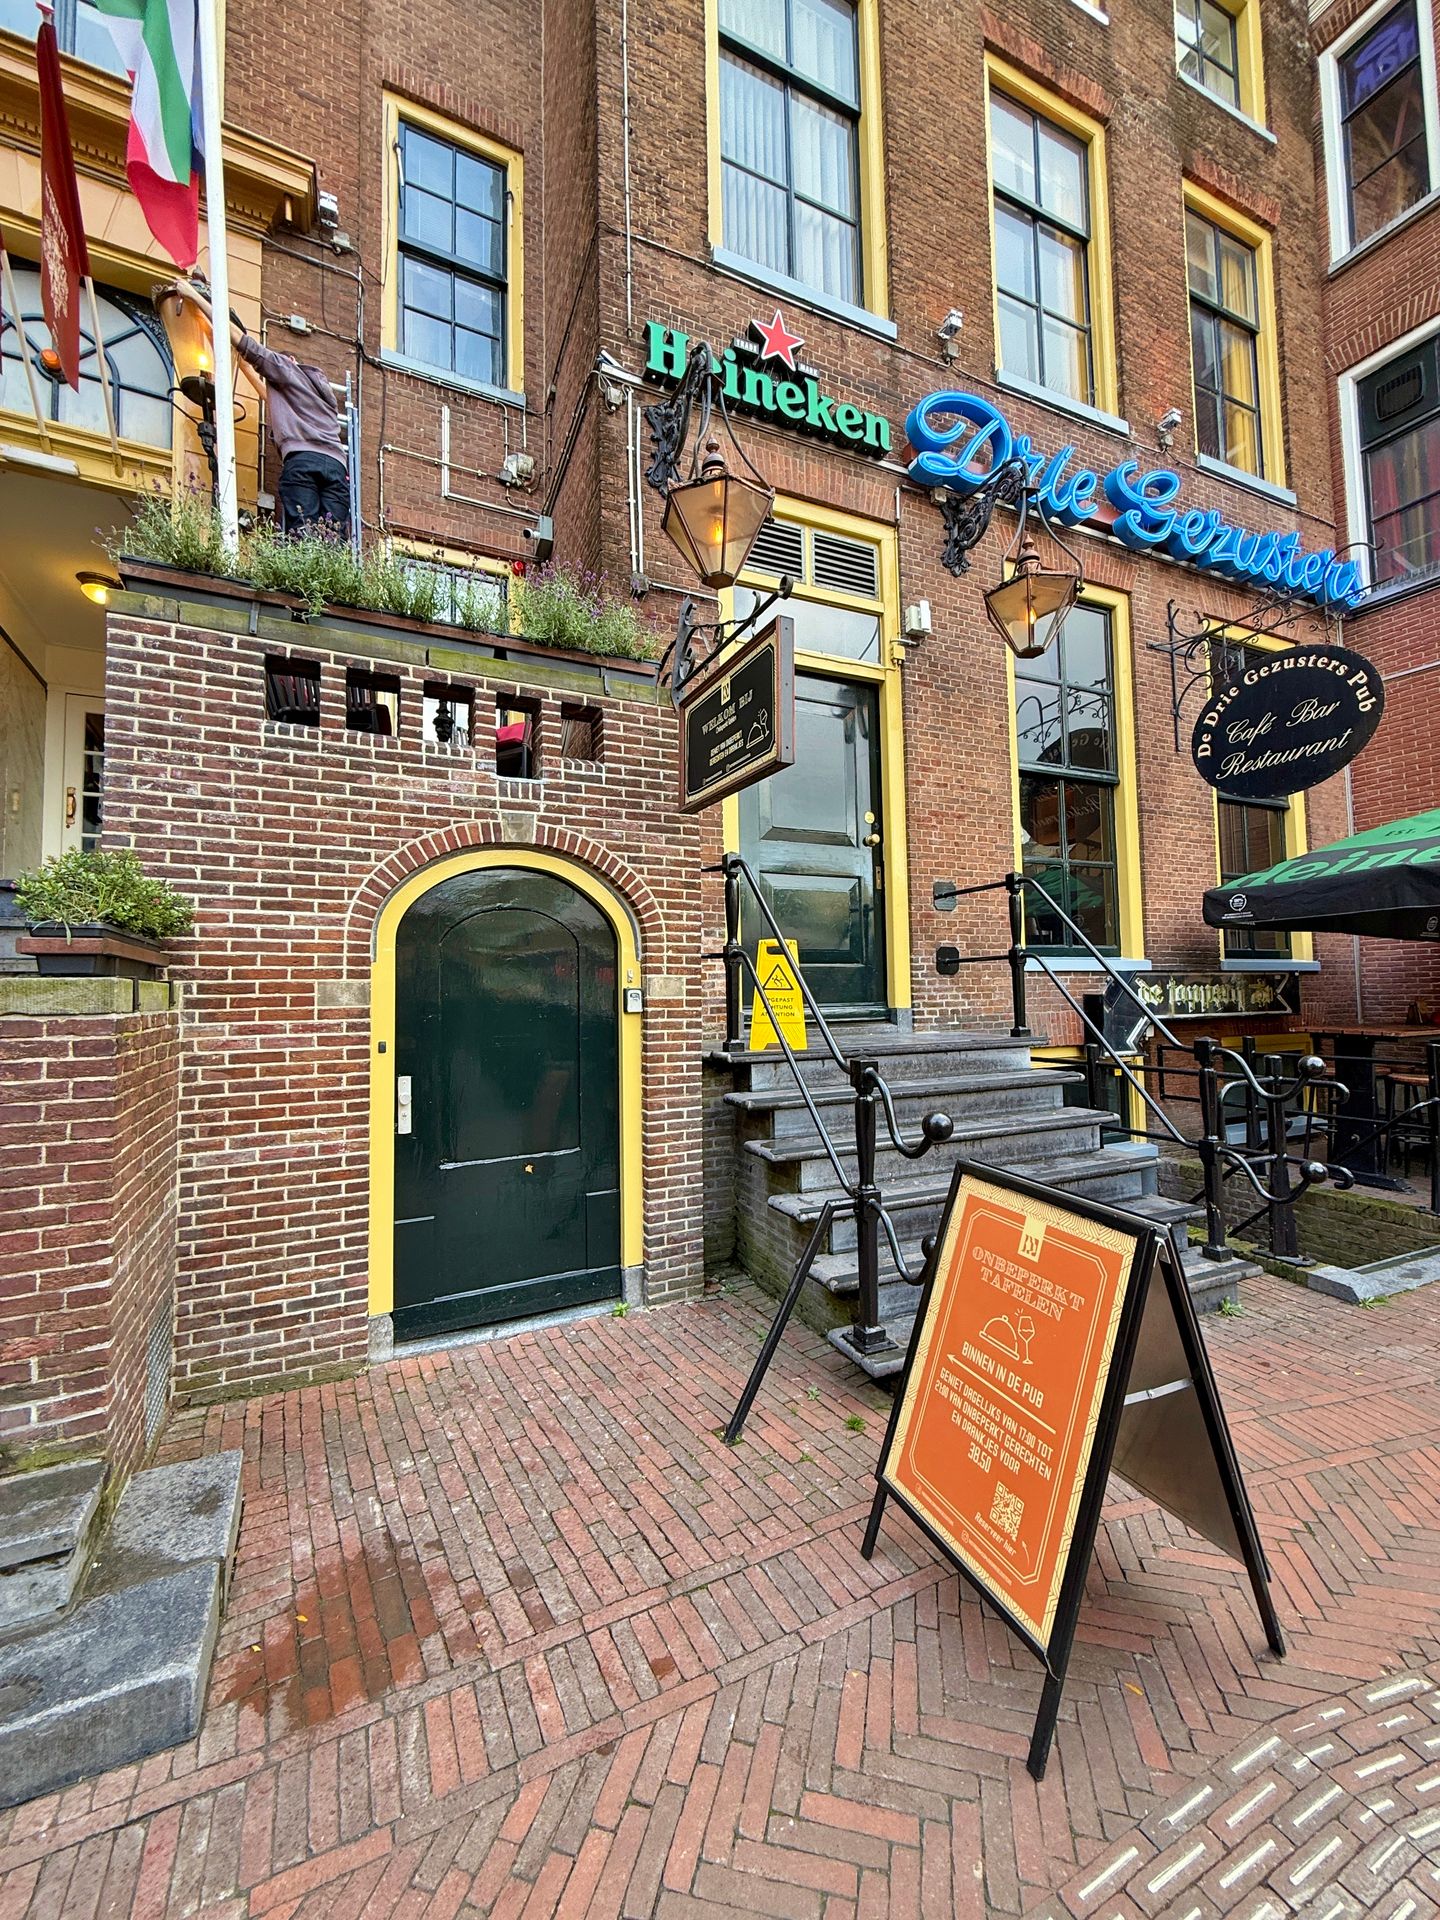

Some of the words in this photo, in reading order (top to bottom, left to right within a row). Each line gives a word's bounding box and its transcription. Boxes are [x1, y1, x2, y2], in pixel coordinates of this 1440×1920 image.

[906, 390, 1099, 521] Drie
[1104, 460, 1366, 608] Gezusters
[1243, 654, 1349, 686] Gezusters
[1347, 670, 1377, 712] Pub
[1203, 686, 1240, 727] Drie
[1226, 711, 1277, 746] Café
[1285, 697, 1341, 727] Bar
[1197, 733, 1212, 758] De
[1215, 727, 1353, 779] Restaurant
[972, 1246, 1085, 1312] ONBEPERKT
[981, 1266, 1064, 1321] TAFELEN
[961, 1341, 996, 1375] BINNEN
[995, 1364, 1007, 1383] IN
[1007, 1371, 1022, 1393] DE
[1022, 1382, 1044, 1408] PUB
[940, 1367, 964, 1392] GENIET
[963, 1385, 1002, 1421] DAGELIJKS
[1002, 1413, 1018, 1434] VAN
[1019, 1426, 1036, 1449] 17:00
[1037, 1439, 1053, 1461] TOT
[949, 1390, 963, 1409] VAN
[962, 1402, 1005, 1442] ONBEPERKT
[1004, 1434, 1052, 1480] GERECHTEN
[951, 1410, 962, 1427] EN
[961, 1419, 1000, 1457] DRANKJES
[1000, 1448, 1021, 1475] VOOR
[968, 1442, 992, 1473] 38.50
[974, 1511, 1004, 1544] Reserveer
[1003, 1539, 1017, 1557] hier
